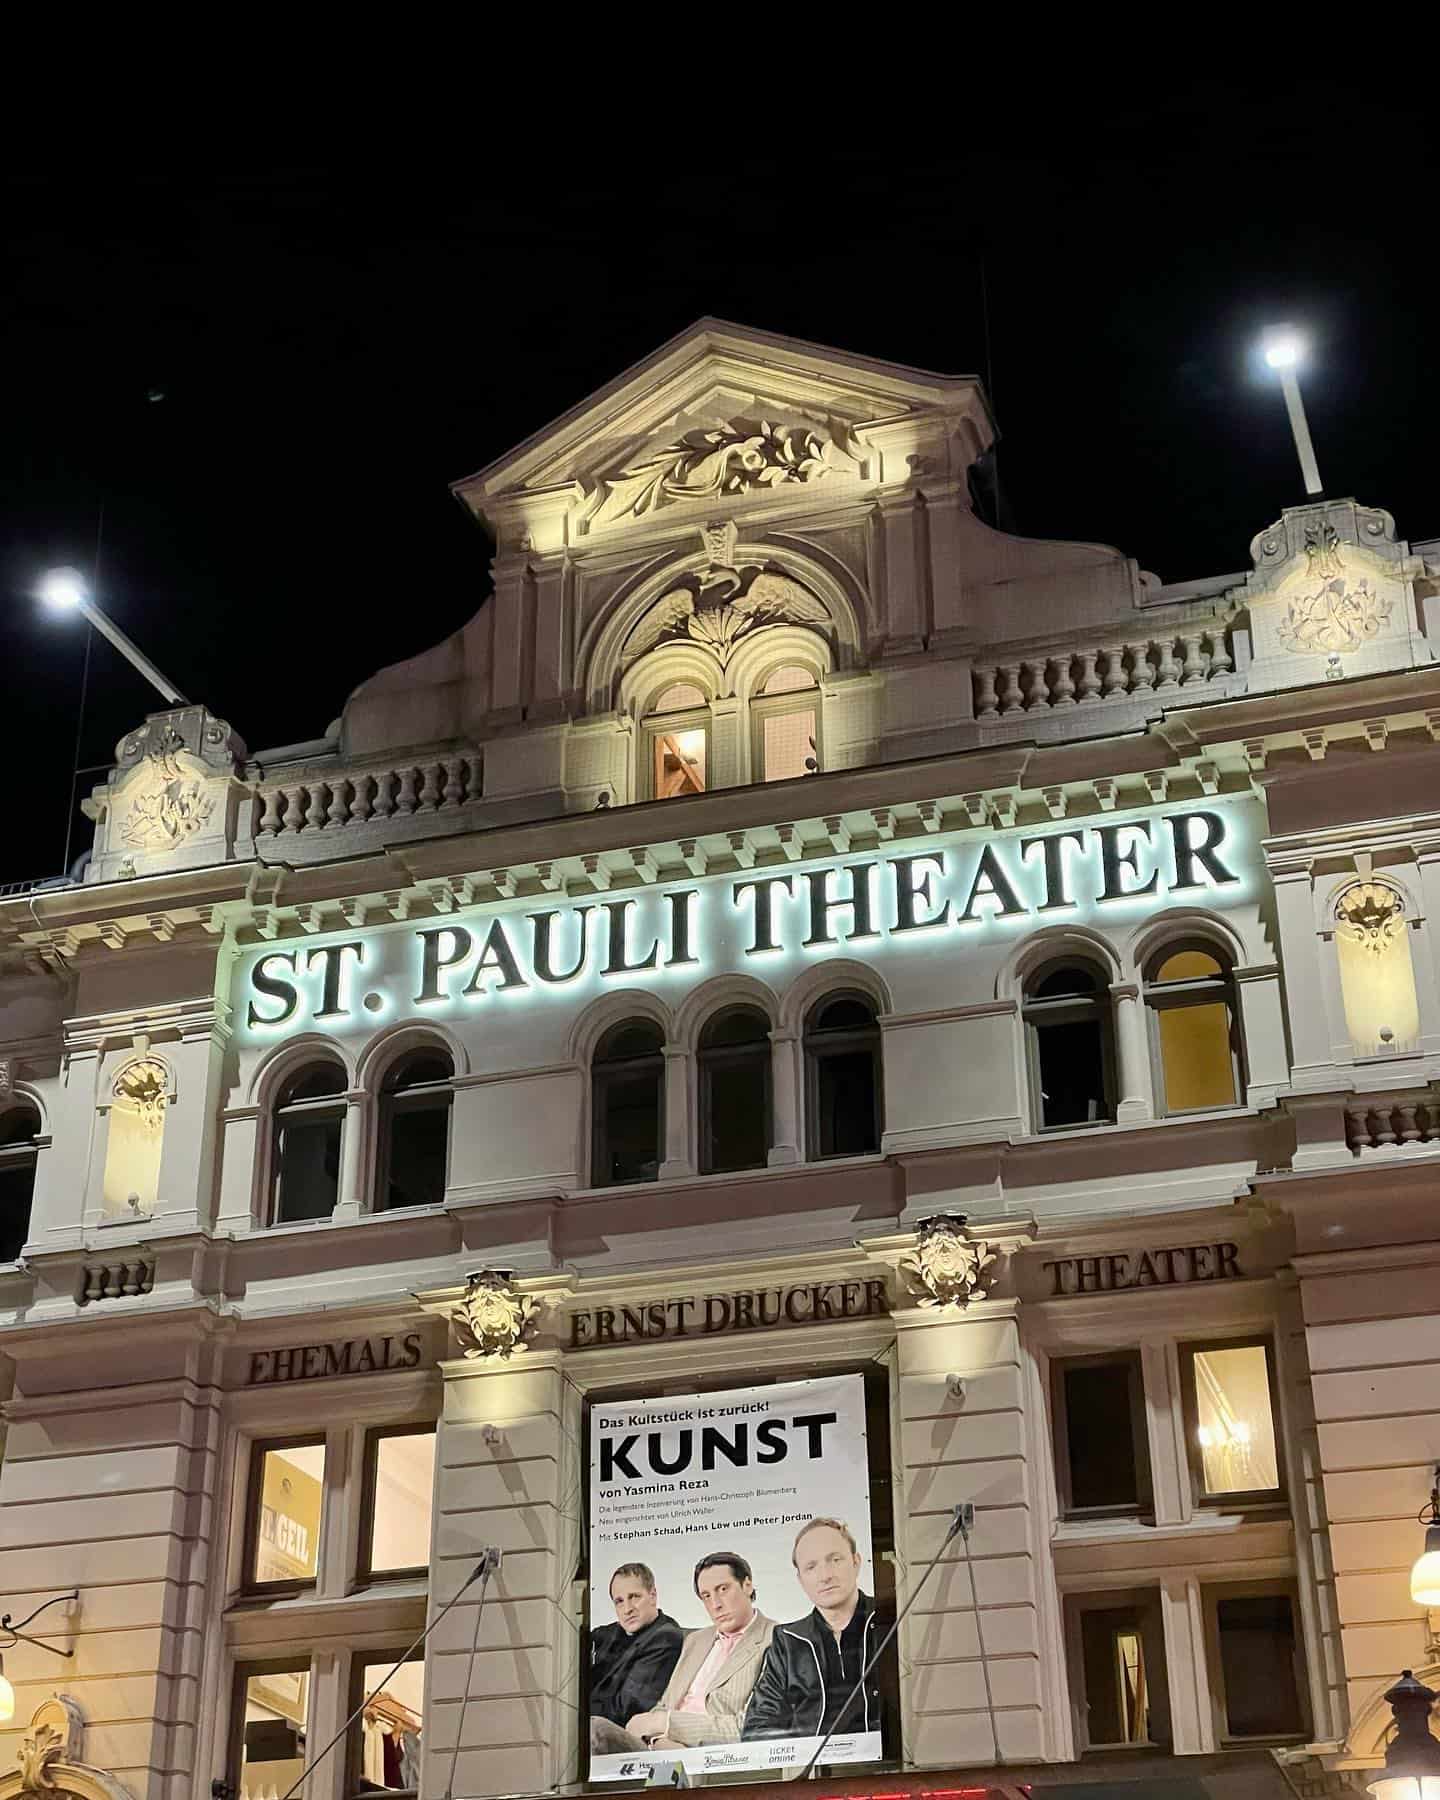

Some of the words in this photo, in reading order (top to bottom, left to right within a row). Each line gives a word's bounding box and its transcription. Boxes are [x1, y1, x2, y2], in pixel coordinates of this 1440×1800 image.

[247, 941, 385, 1031] ST.
[414, 889, 700, 1005] PAULI
[733, 810, 1241, 956] THEATER
[1043, 1242, 1242, 1296] THEATER
[570, 1300, 700, 1347] ERNST
[702, 1279, 889, 1335] DRUCKER
[248, 1333, 422, 1385] EHEMALS
[599, 1418, 624, 1429] Das
[628, 1410, 694, 1426] Kultstück
[698, 1407, 715, 1419] ist
[719, 1401, 769, 1417] zurück!
[600, 1412, 837, 1482] KUNST
[599, 1489, 622, 1499] von
[623, 1482, 675, 1496] Yasmina
[679, 1479, 710, 1490] Reza
[670, 1508, 692, 1519] Ulrich
[277, 1513, 309, 1568] GEIL
[613, 1529, 652, 1541] Stephan
[653, 1525, 684, 1537] Schad,
[685, 1522, 709, 1533] Hans
[732, 1517, 751, 1528] und
[753, 1515, 779, 1526] Peter
[781, 1512, 814, 1525] Jordan
